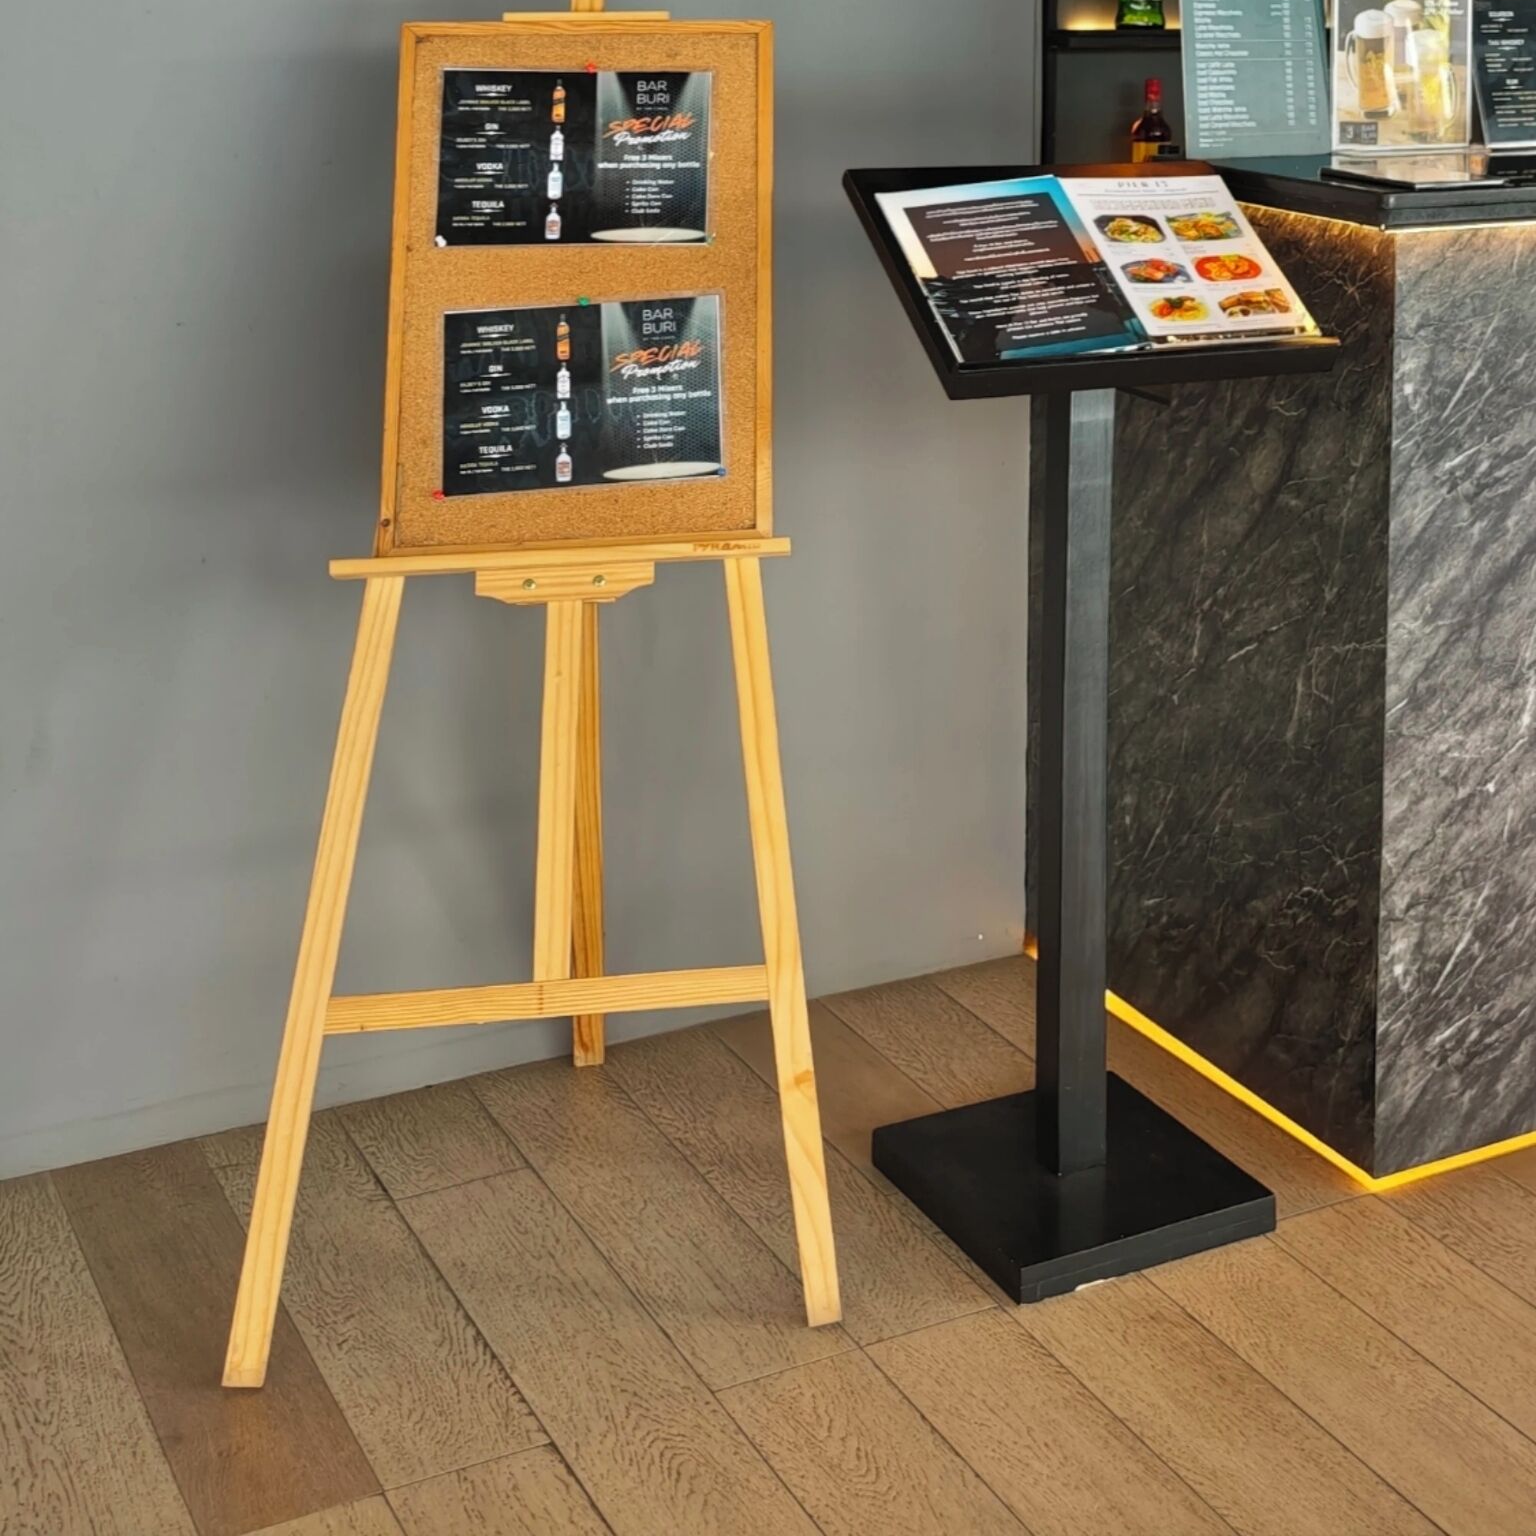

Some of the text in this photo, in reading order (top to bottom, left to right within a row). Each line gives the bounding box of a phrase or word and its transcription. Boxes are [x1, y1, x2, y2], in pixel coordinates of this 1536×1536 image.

[475, 84, 512, 93] WHISKEY
[636, 80, 668, 92] BAR
[636, 93, 670, 104] BURI
[484, 123, 499, 131] GIN
[604, 112, 696, 139] SPECIAL
[613, 130, 693, 151] Promotion
[476, 162, 504, 170] VODKA
[471, 200, 505, 209] TEQUILA
[642, 308, 673, 321] BAR
[476, 324, 514, 334] WHISKEY
[642, 321, 677, 334] BURI
[609, 339, 702, 373] SPECIAL
[488, 365, 503, 373] GIN
[621, 359, 700, 381] Promotion
[481, 405, 510, 414] VODKA
[478, 445, 513, 454] TEQUILA
